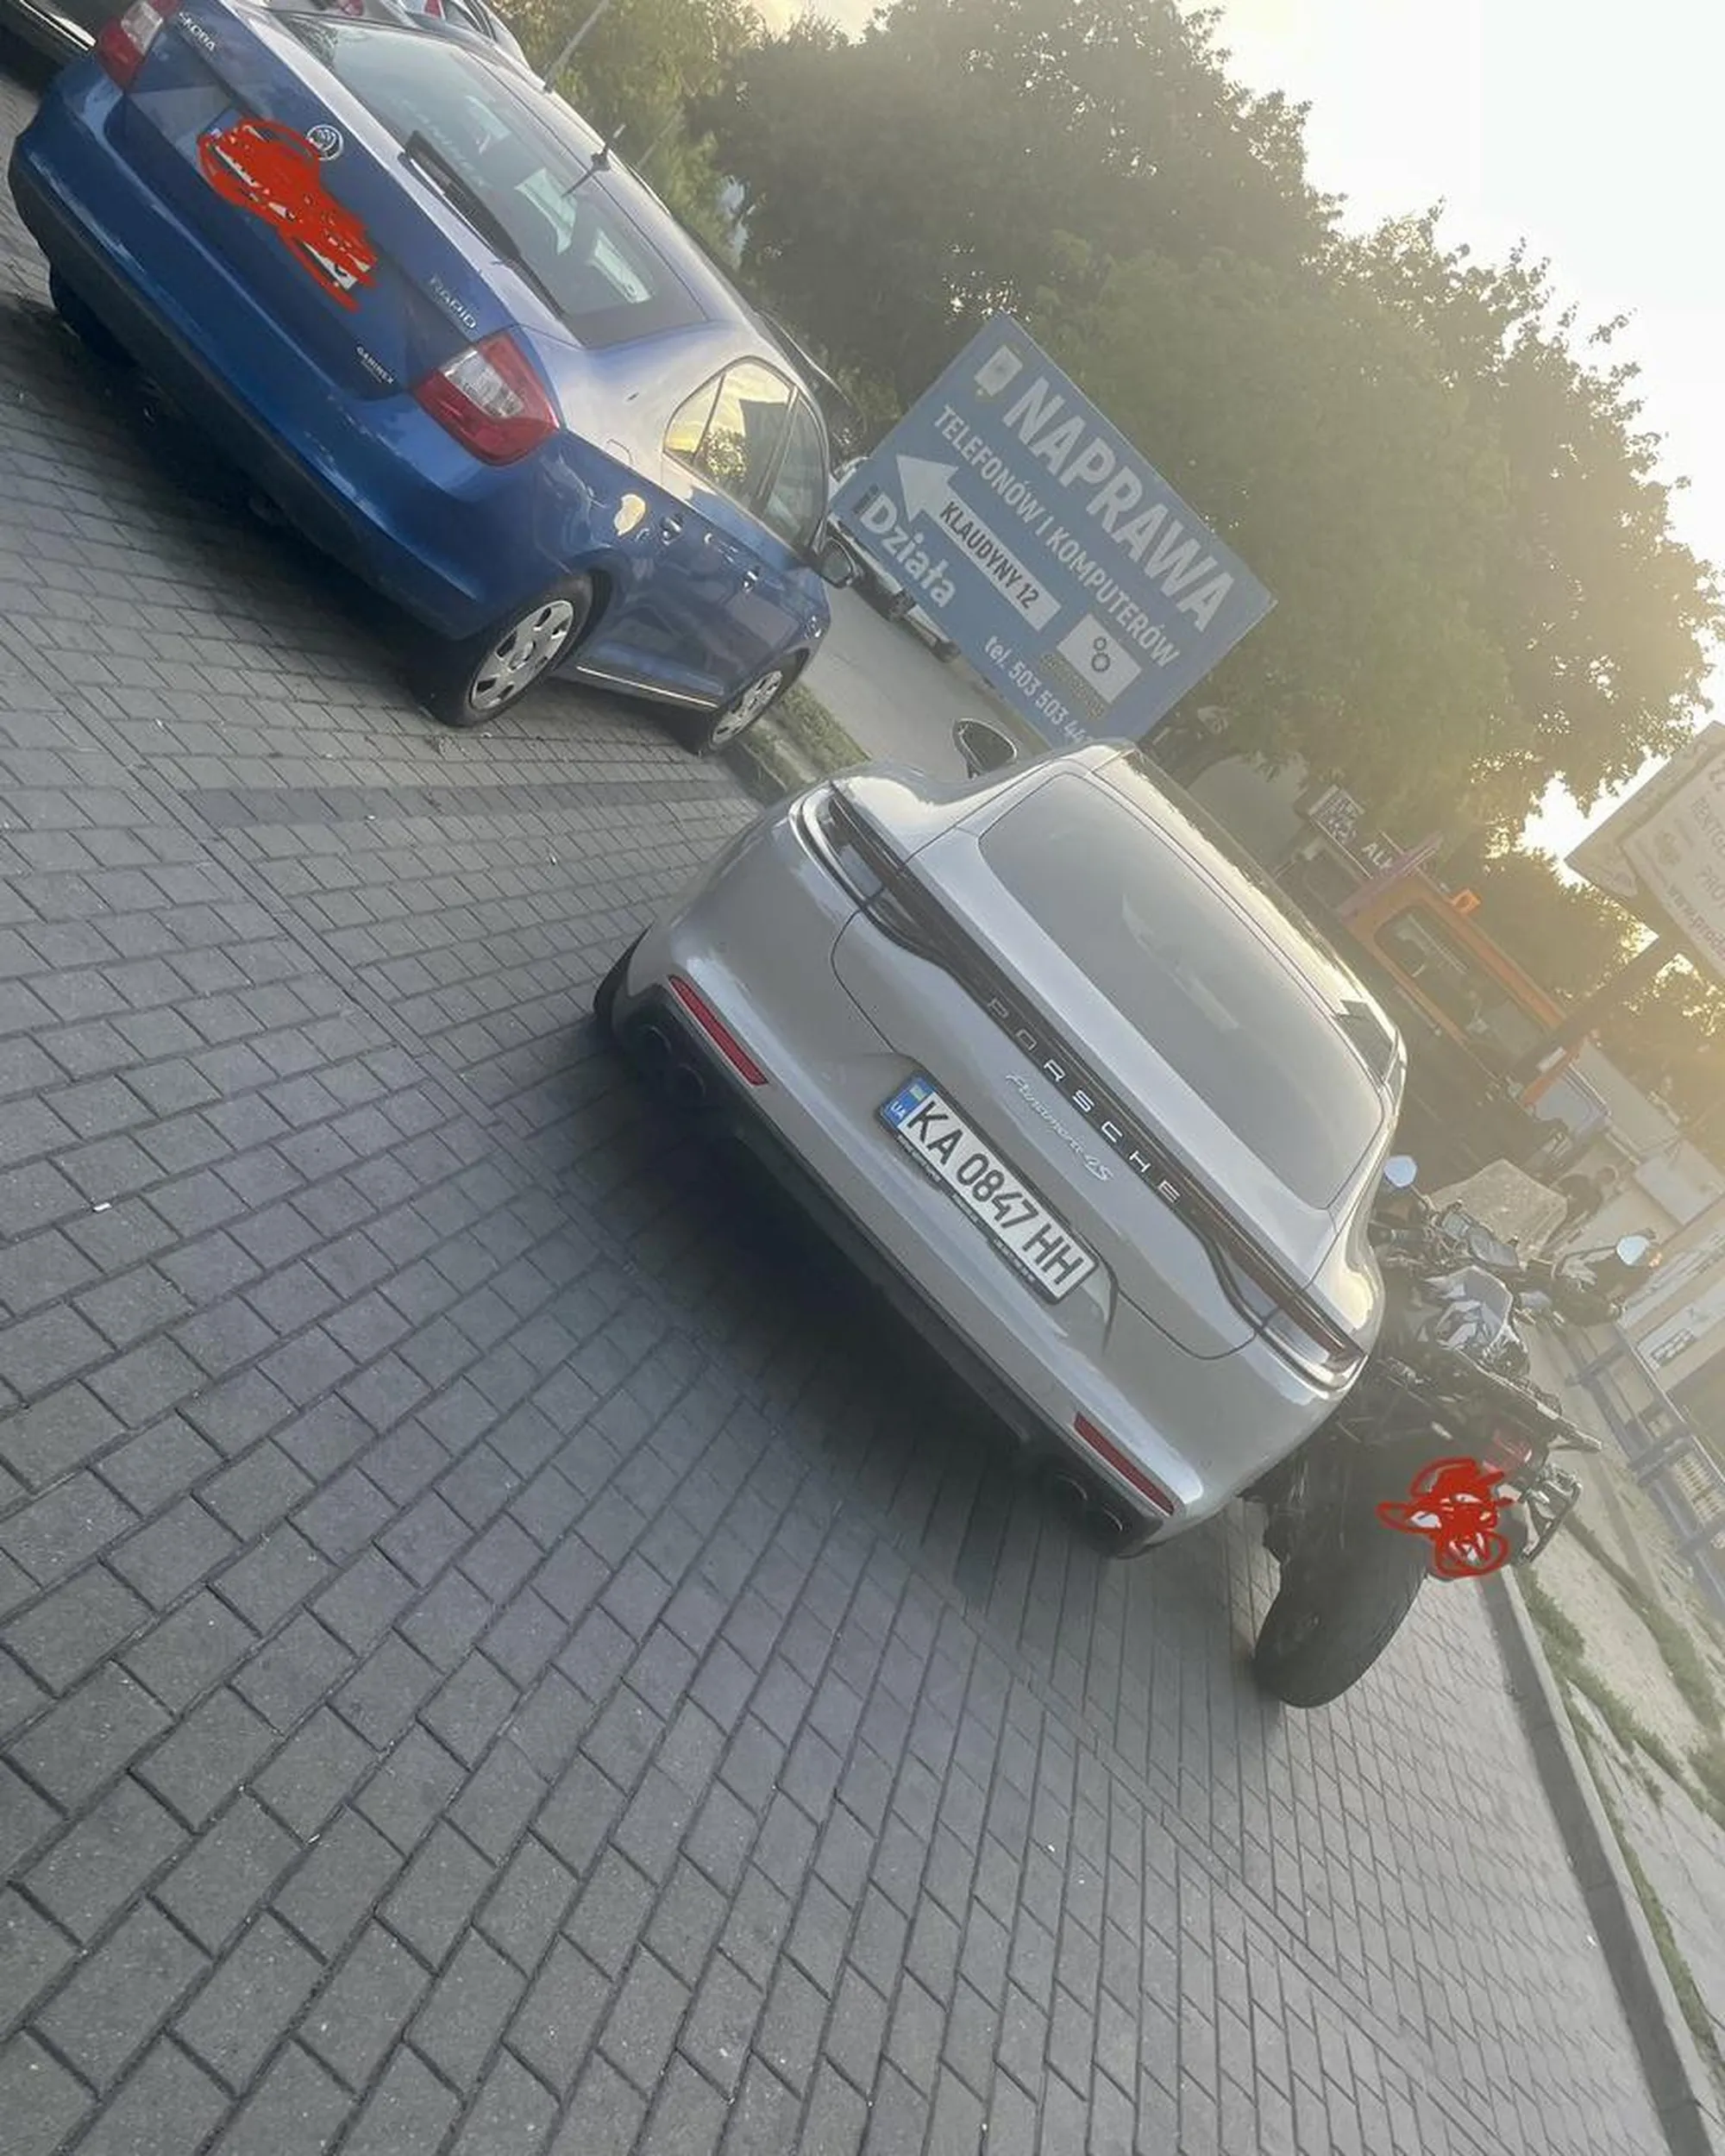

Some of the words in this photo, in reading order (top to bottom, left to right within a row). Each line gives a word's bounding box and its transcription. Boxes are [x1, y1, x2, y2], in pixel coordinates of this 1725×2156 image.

[934, 405, 1047, 524] TELEFONÓW
[1045, 526, 1180, 668] KOMPUTERÓW
[938, 499, 1024, 592] KLAUDYNY
[1014, 584, 1040, 611] 12
[1003, 378, 1235, 631] NAPRAWA
[984, 635, 1011, 668] tel.
[1007, 661, 1041, 697] 503
[1038, 687, 1070, 726] 503
[890, 1100, 907, 1119] UA
[986, 997, 1181, 1203] PORSCHE
[1084, 1152, 1115, 1181] 4S
[907, 1100, 963, 1165] KA
[956, 1153, 1038, 1230] 0847
[1022, 1223, 1084, 1288] HH
